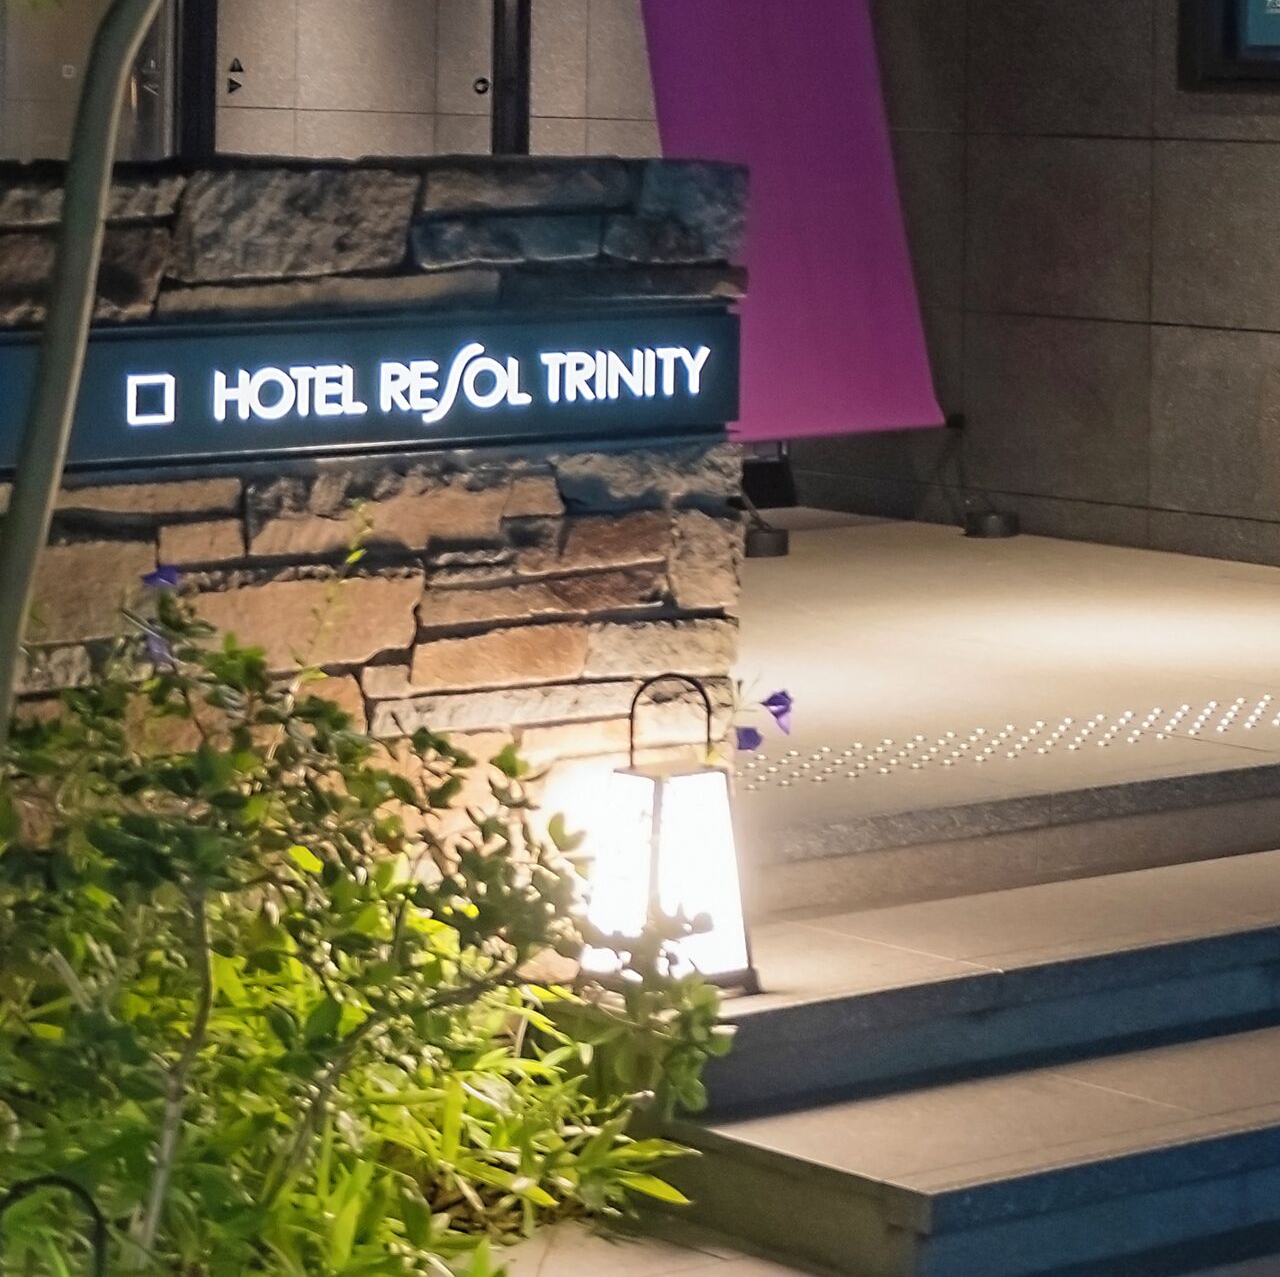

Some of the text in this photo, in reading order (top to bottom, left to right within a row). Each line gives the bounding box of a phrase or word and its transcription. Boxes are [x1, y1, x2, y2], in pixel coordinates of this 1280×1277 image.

[213, 342, 711, 424] HOTEL RESOL TRINITY
